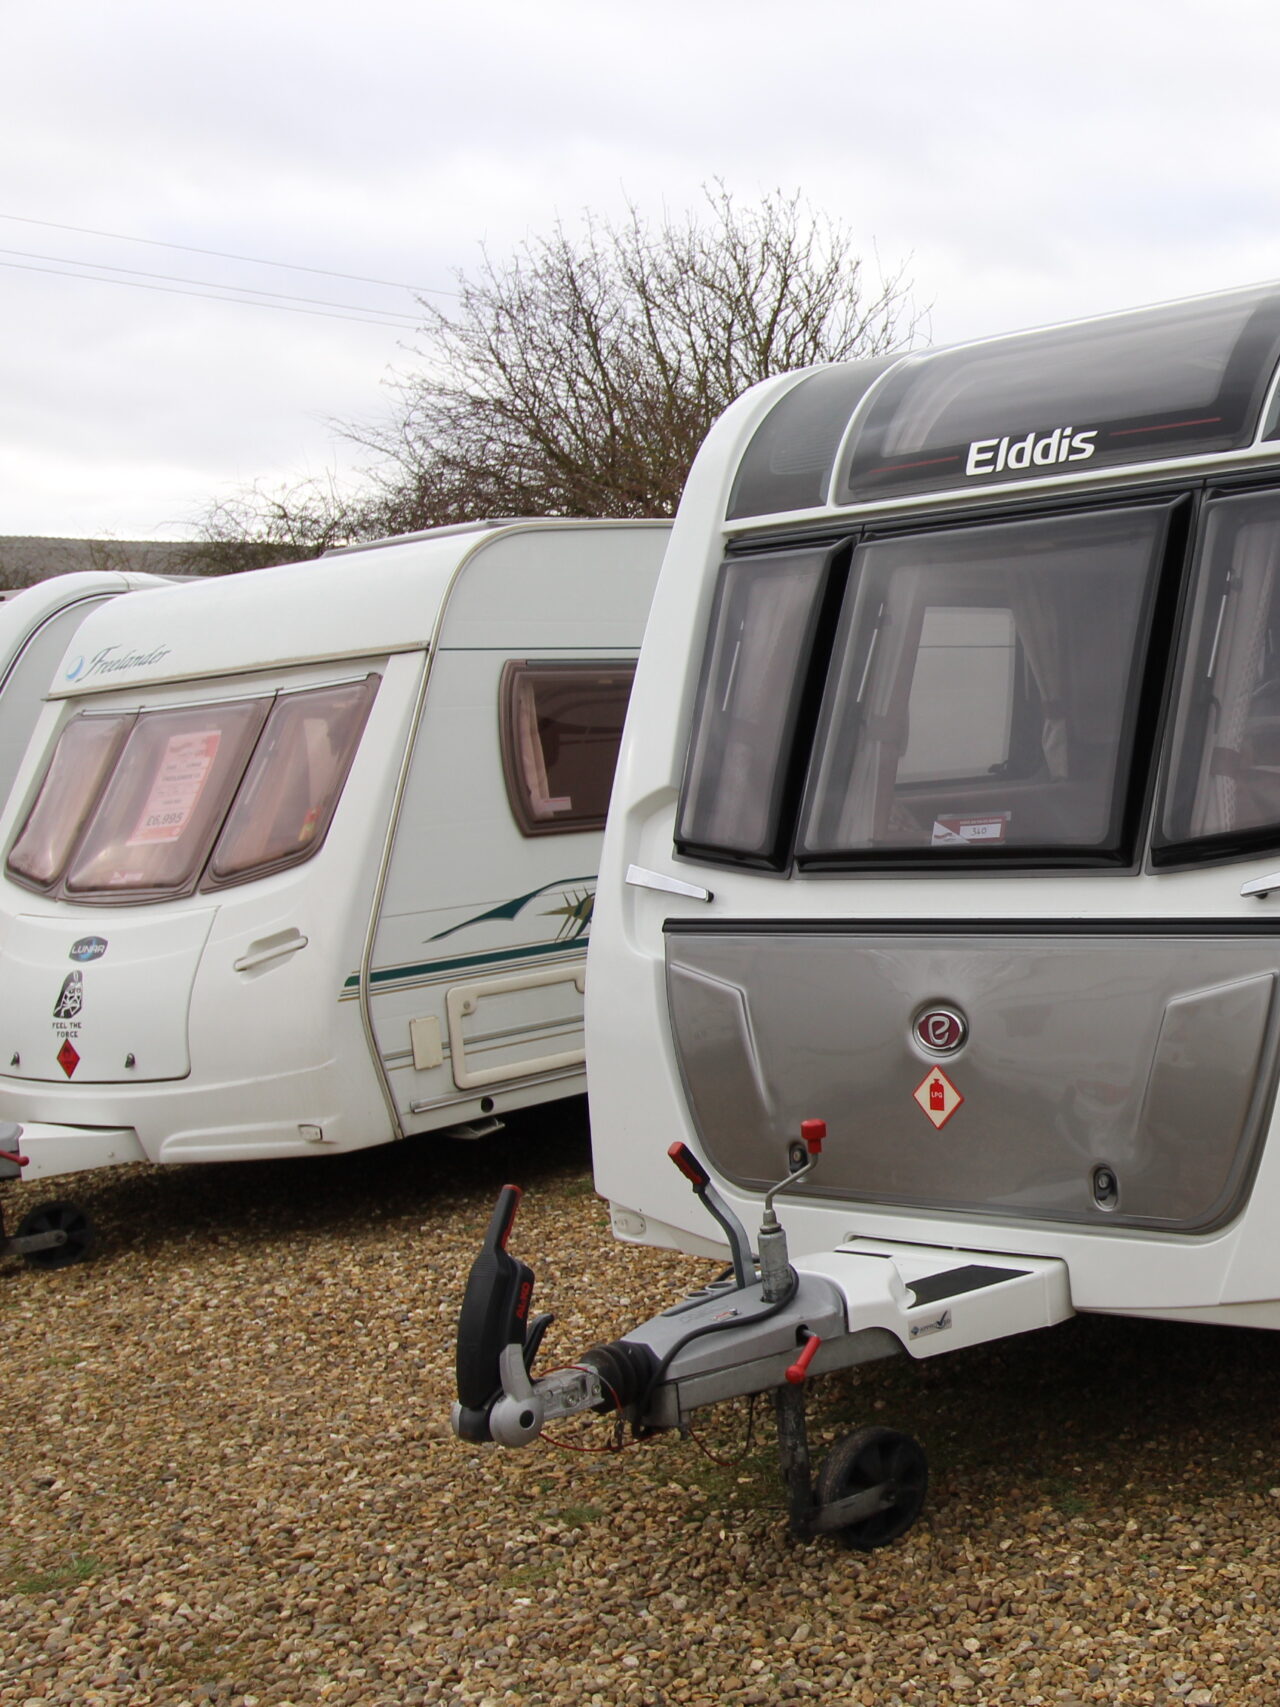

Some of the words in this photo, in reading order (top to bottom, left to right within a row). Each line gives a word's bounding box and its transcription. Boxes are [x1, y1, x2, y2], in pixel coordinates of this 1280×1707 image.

[965, 426, 1098, 476] Elddis
[75, 644, 172, 683] Freelander
[71, 944, 105, 955] LUNAR
[931, 1091, 943, 1099] LPG
